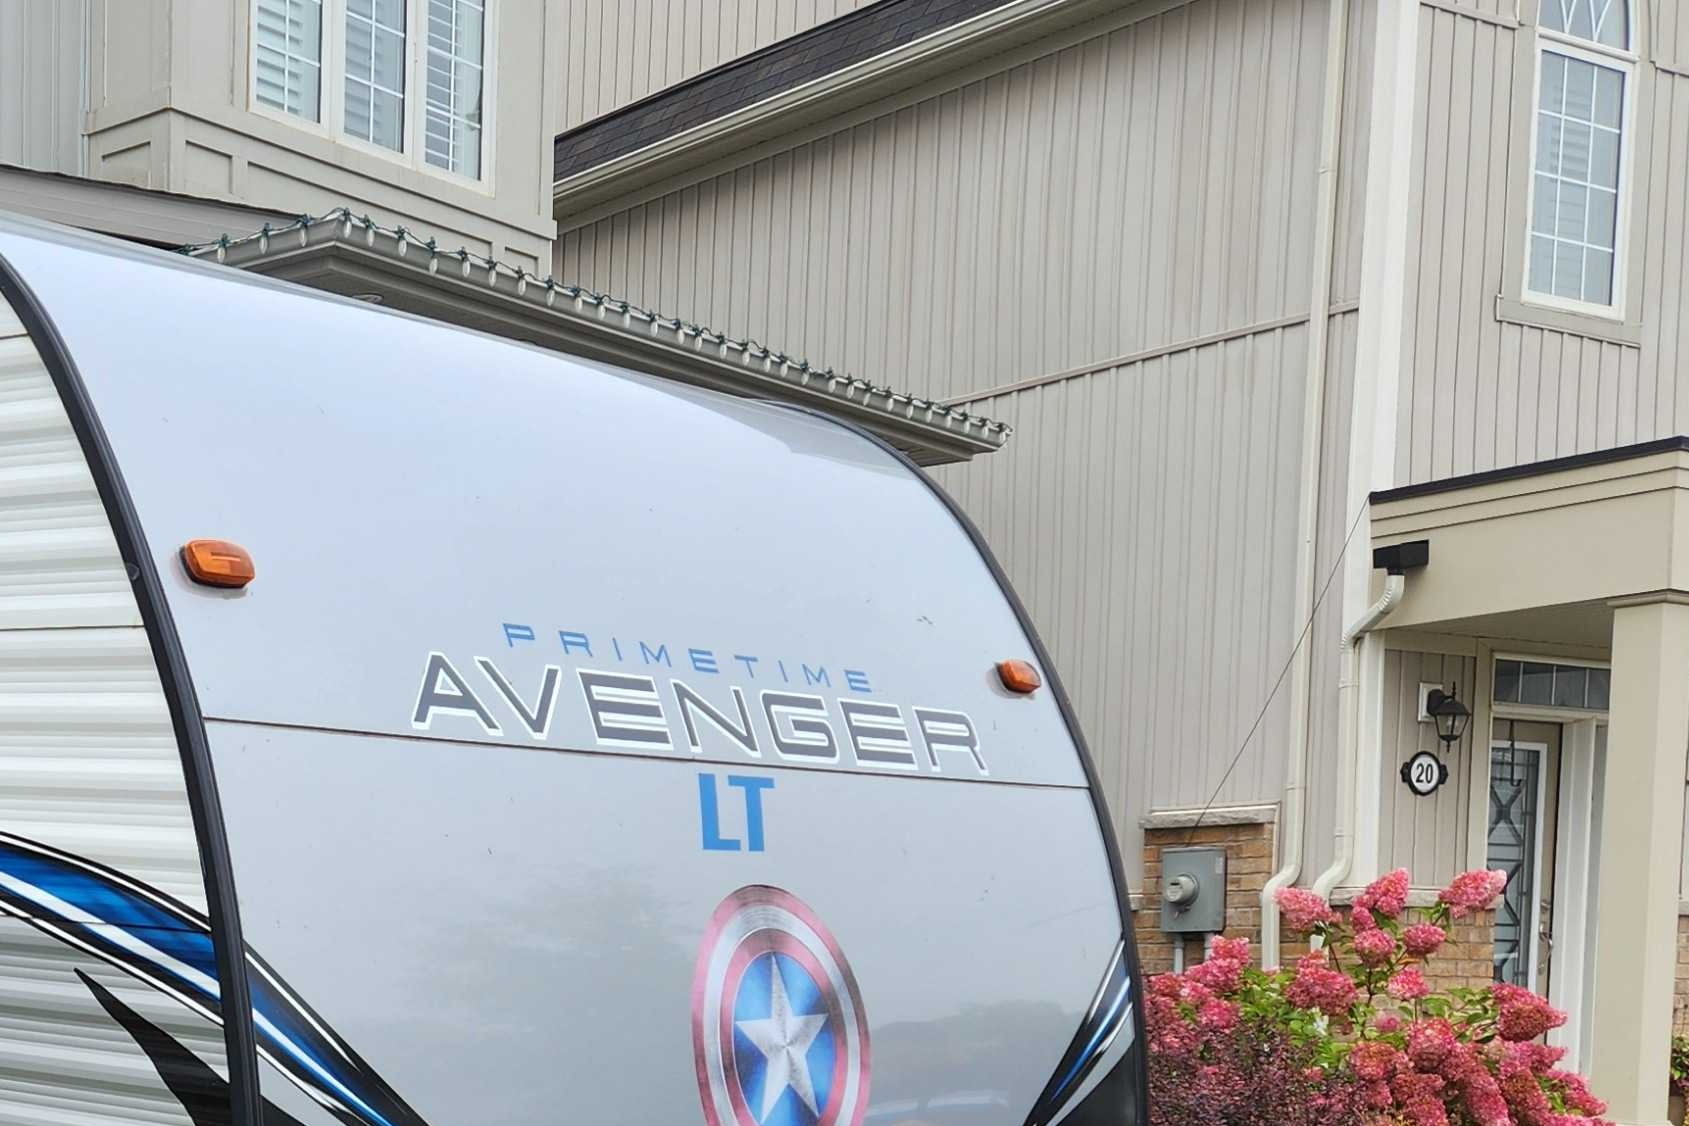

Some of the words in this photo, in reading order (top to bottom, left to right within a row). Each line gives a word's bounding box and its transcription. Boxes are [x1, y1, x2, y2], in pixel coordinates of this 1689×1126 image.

[411, 650, 990, 776] AVENGER
[698, 772, 775, 852] LT
[1415, 763, 1433, 784] 20
